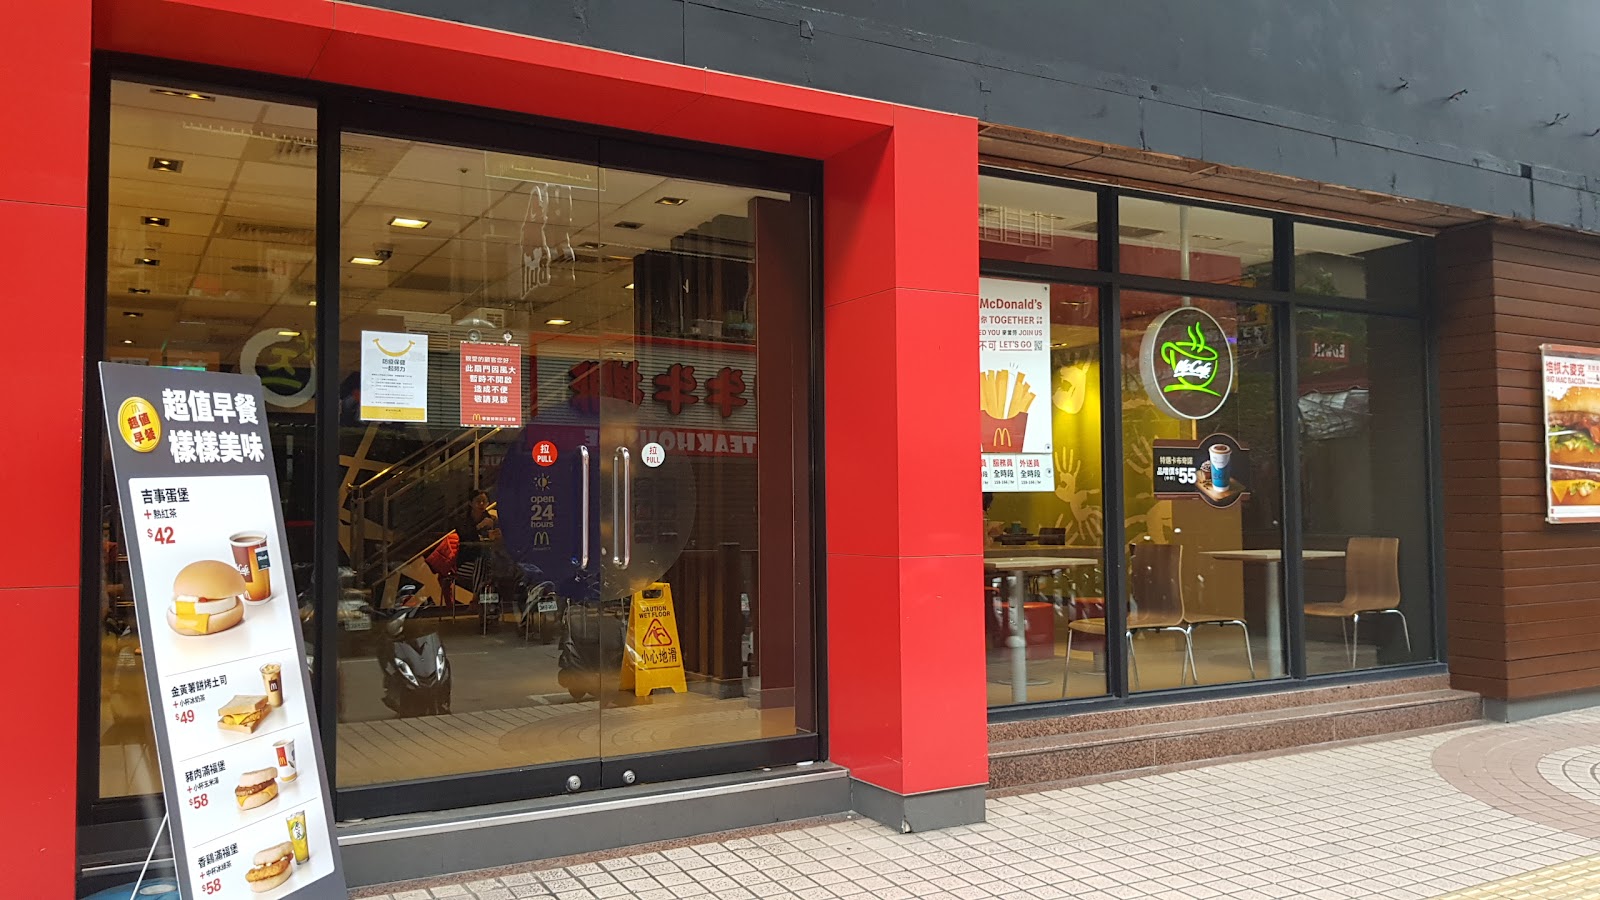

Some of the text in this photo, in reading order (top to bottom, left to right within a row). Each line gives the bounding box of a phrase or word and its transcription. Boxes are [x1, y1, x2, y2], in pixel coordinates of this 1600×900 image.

[980, 298, 1043, 310] McDonald's
[989, 315, 1035, 325] TOGETHER
[999, 340, 1019, 348] LET'S
[1020, 340, 1032, 348] GO
[473, 384, 509, 394] 造成不便
[473, 394, 509, 404] 敬請見諒
[161, 387, 259, 425] 超值早餐
[127, 411, 152, 430] 超值
[133, 427, 157, 445] 早餐
[167, 429, 265, 464] 樣樣美味
[540, 444, 550, 454] 拉
[649, 446, 658, 455] 拉
[537, 455, 553, 463] PULL
[646, 456, 660, 464] PULL
[1019, 458, 1040, 468] 外送員
[993, 469, 1014, 479] 全時段
[1020, 469, 1041, 479] 全時段
[140, 487, 190, 504] 吉事蛋堡
[530, 495, 555, 505] open
[530, 504, 555, 521] 24
[530, 520, 554, 528] hours
[146, 526, 176, 545] $42
[641, 605, 667, 613] CAUTION
[651, 610, 671, 618] FLOOR
[641, 647, 677, 665] 小心地滑
[175, 709, 195, 724] $49
[184, 759, 226, 783] 豬肉滿福堡
[188, 793, 209, 810] $58
[201, 877, 222, 896] $58
